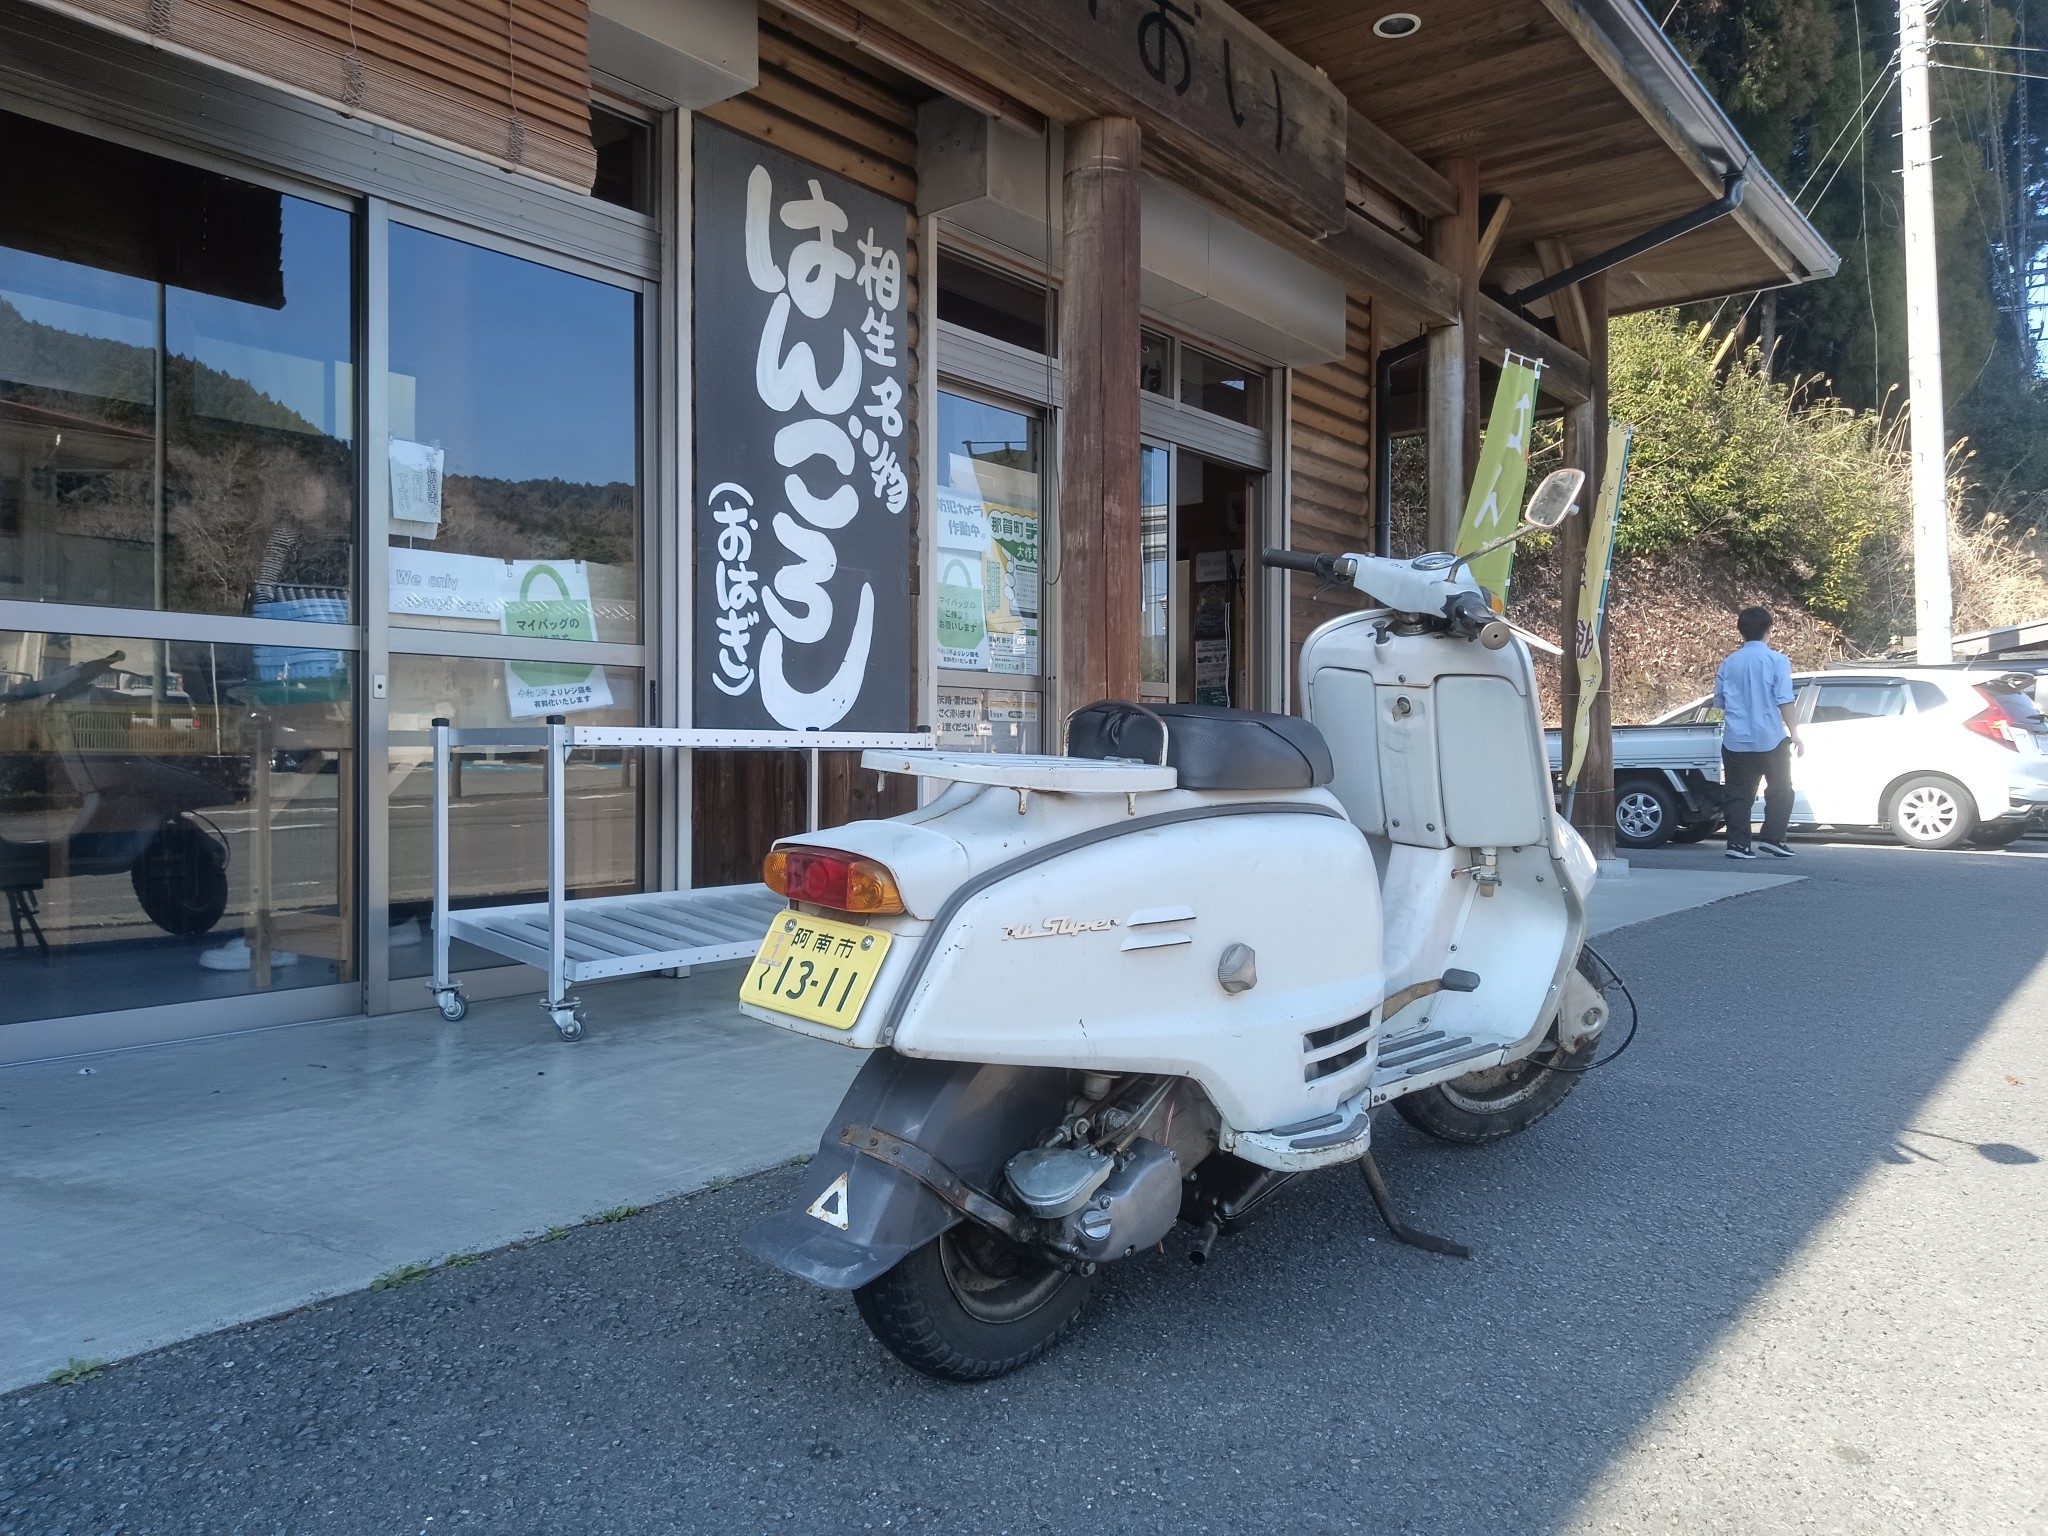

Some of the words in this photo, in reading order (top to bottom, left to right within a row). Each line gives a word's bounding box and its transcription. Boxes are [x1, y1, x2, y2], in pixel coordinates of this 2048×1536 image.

[745, 165, 879, 731] はんごろし
[396, 570, 421, 586] We
[428, 574, 459, 591] only
[516, 618, 580, 631] マイバッグの
[1043, 915, 1121, 937] Super
[791, 927, 857, 959] 阿南市
[772, 956, 858, 1013] 13-11
